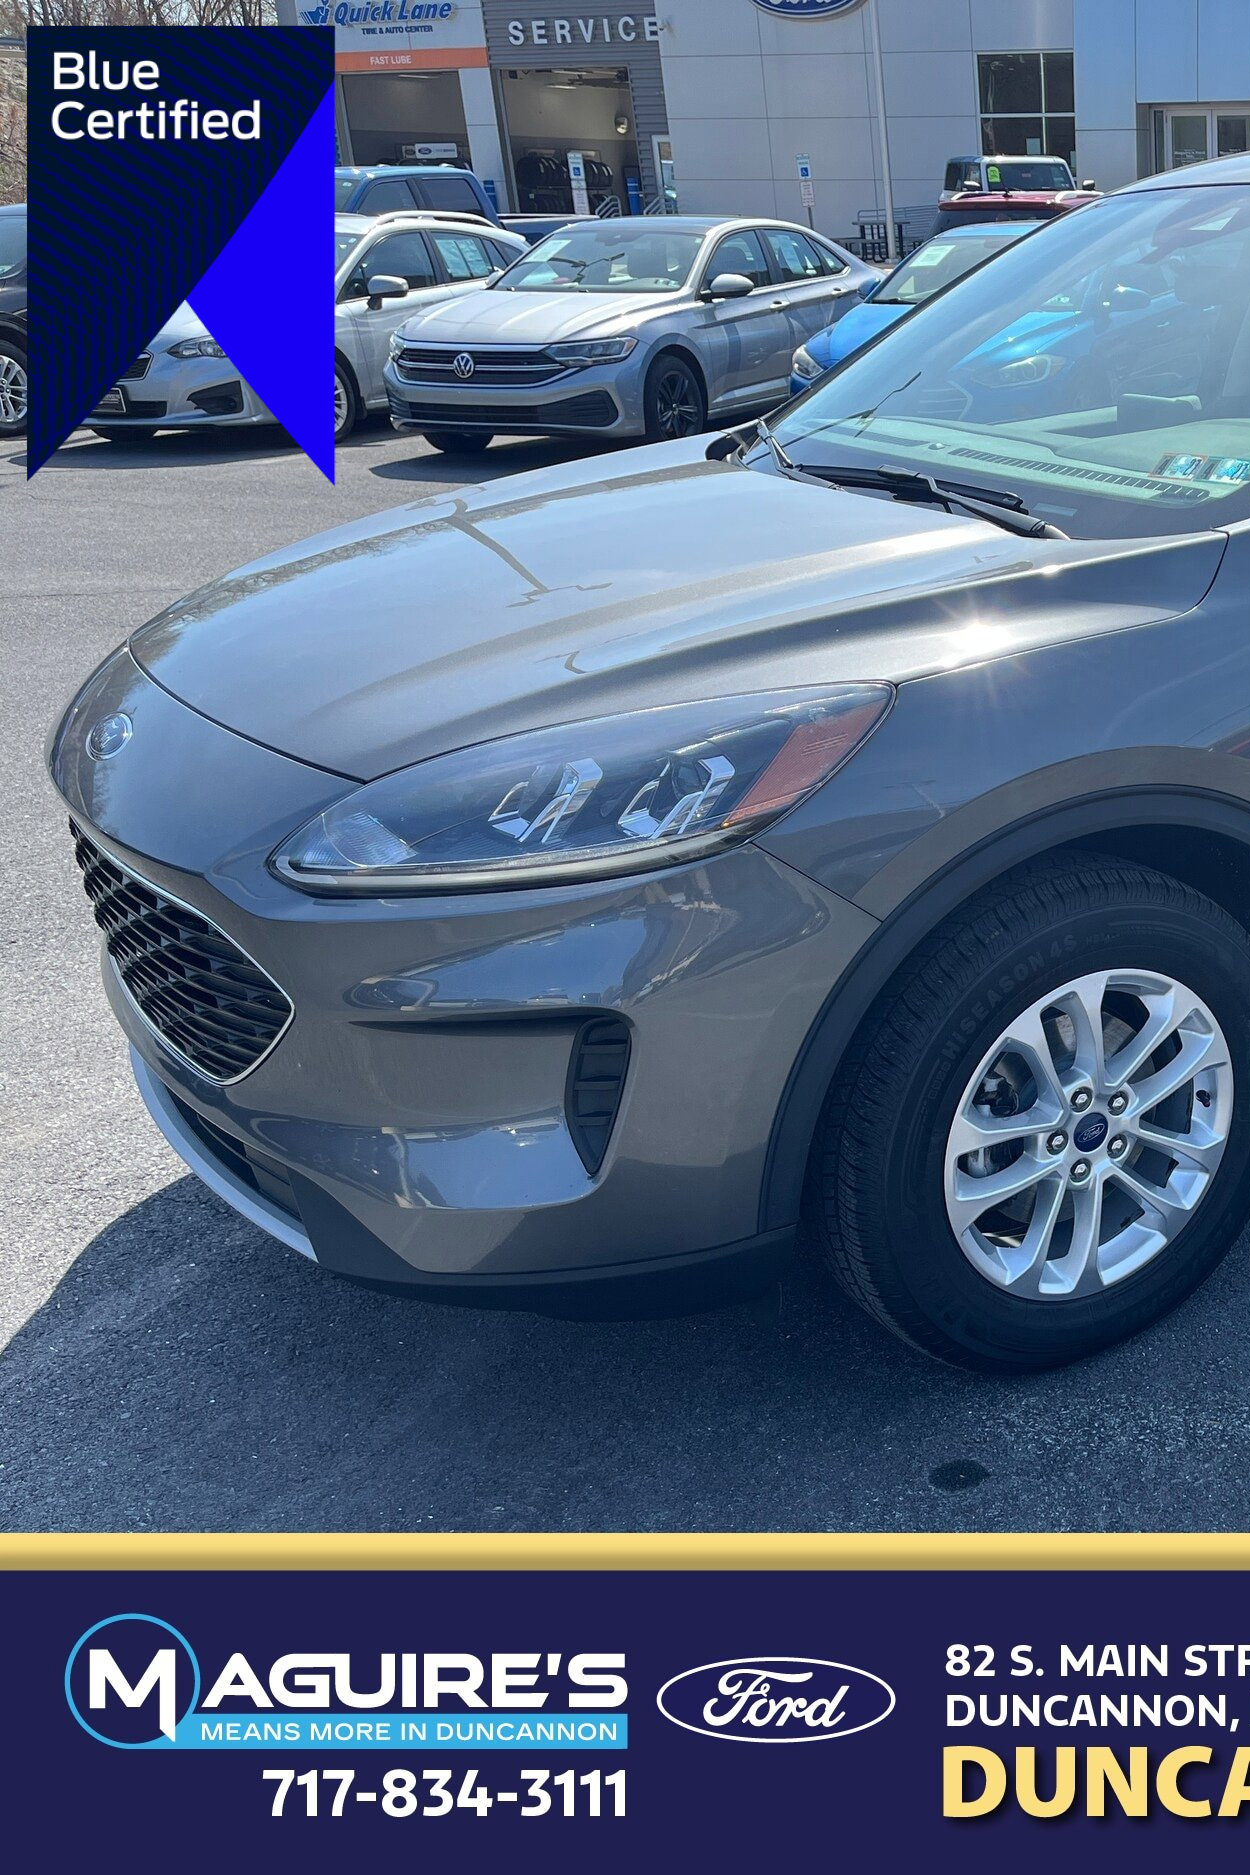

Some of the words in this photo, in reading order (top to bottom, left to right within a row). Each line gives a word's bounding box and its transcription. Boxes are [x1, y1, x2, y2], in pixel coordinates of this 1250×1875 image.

[334, 0, 394, 26] Quick
[397, 0, 453, 21] Lane
[361, 27, 378, 35] TIRE
[378, 27, 385, 35] &
[385, 26, 403, 34] AUTO
[404, 25, 434, 34] CENTER
[508, 16, 660, 46] SERVICE
[370, 56, 390, 65] FAST
[390, 55, 412, 65] LUBE
